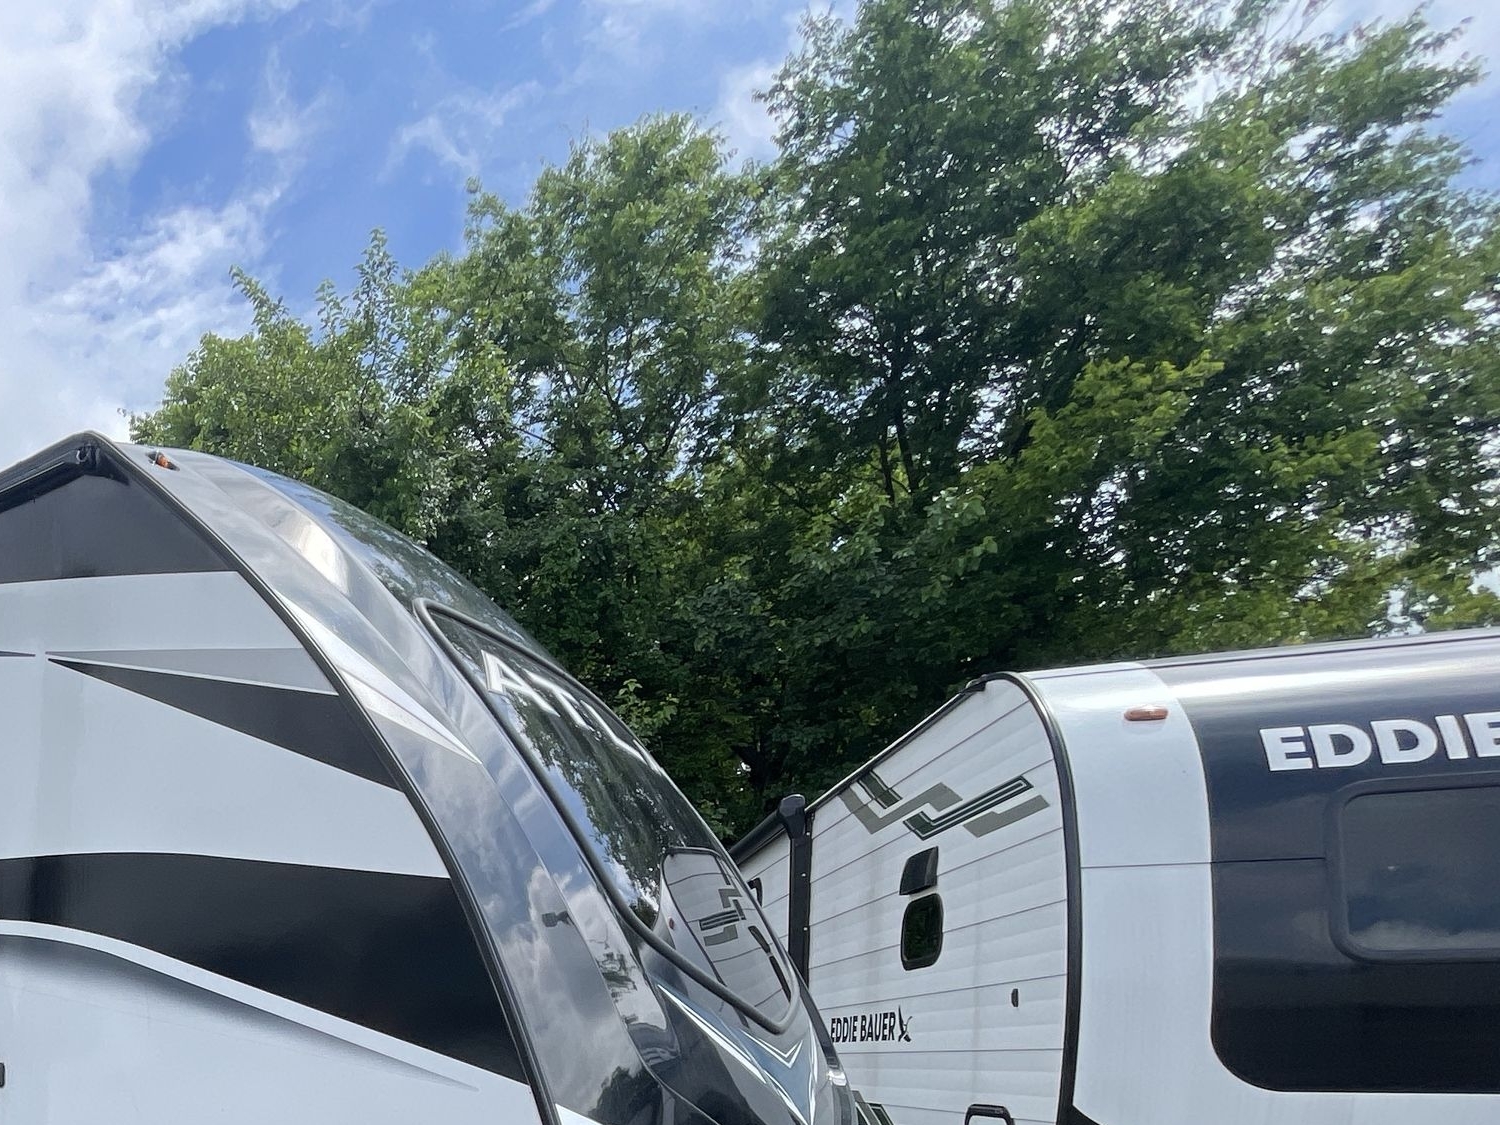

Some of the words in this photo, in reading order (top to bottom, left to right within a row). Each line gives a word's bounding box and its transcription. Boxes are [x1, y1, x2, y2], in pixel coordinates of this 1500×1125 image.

[1260, 711, 1500, 771] EDDIE
[830, 1015, 858, 1043] EDDIE
[859, 1011, 896, 1042] BAUER
